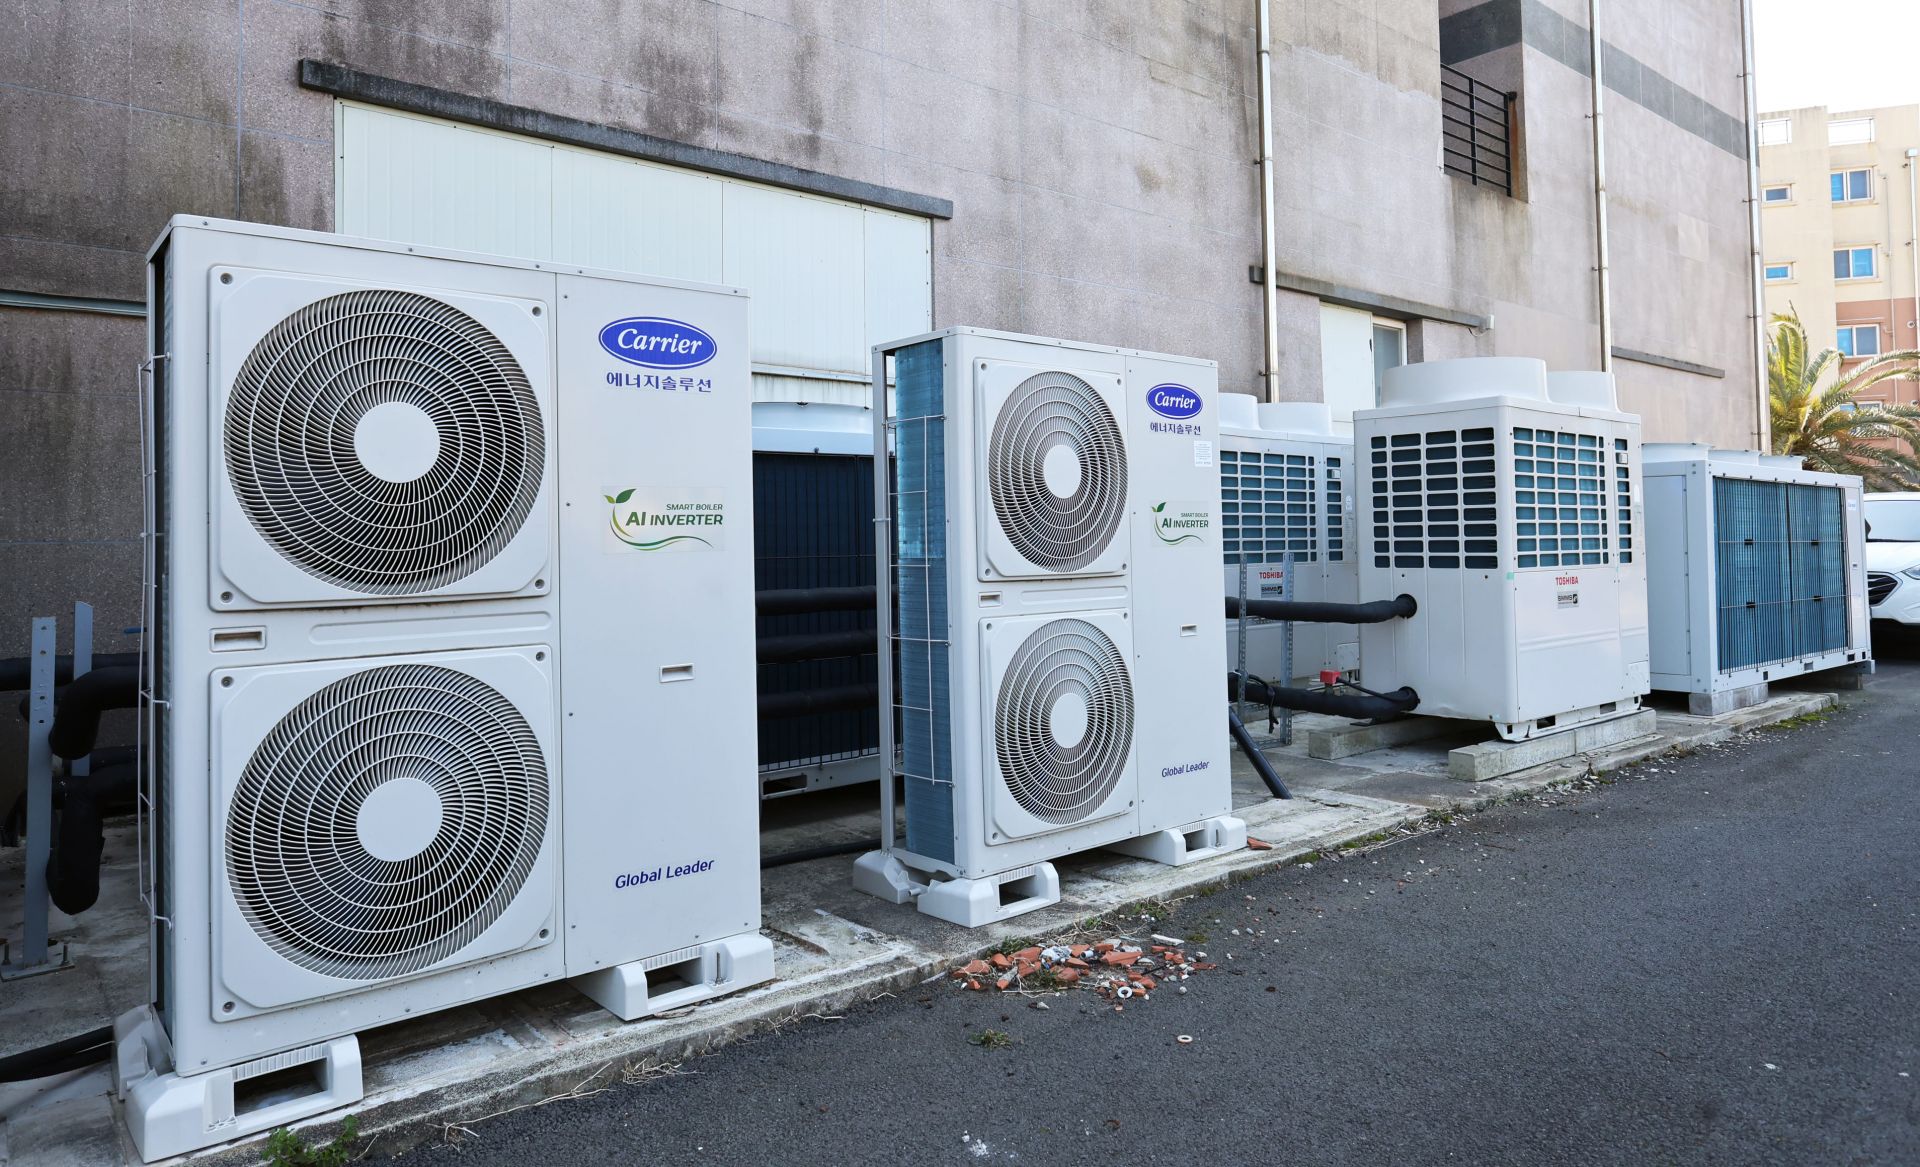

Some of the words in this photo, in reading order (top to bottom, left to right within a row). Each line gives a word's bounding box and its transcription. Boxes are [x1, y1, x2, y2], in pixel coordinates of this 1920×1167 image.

[617, 328, 702, 354] Carrier
[606, 372, 711, 392] 에너지솔루션
[1154, 391, 1196, 409] Carrier
[1150, 422, 1201, 436] 에너지솔루션
[625, 511, 646, 526] AI
[650, 514, 723, 526] INVERTER
[1161, 517, 1172, 529] AI
[1173, 519, 1209, 528] INVERTER
[1259, 571, 1283, 579] TOSHIBA
[1555, 576, 1579, 586] TOSHIBA
[1161, 764, 1185, 778] Global
[1185, 760, 1210, 773] Leader
[615, 867, 662, 889] Global
[666, 859, 715, 879] Leader
